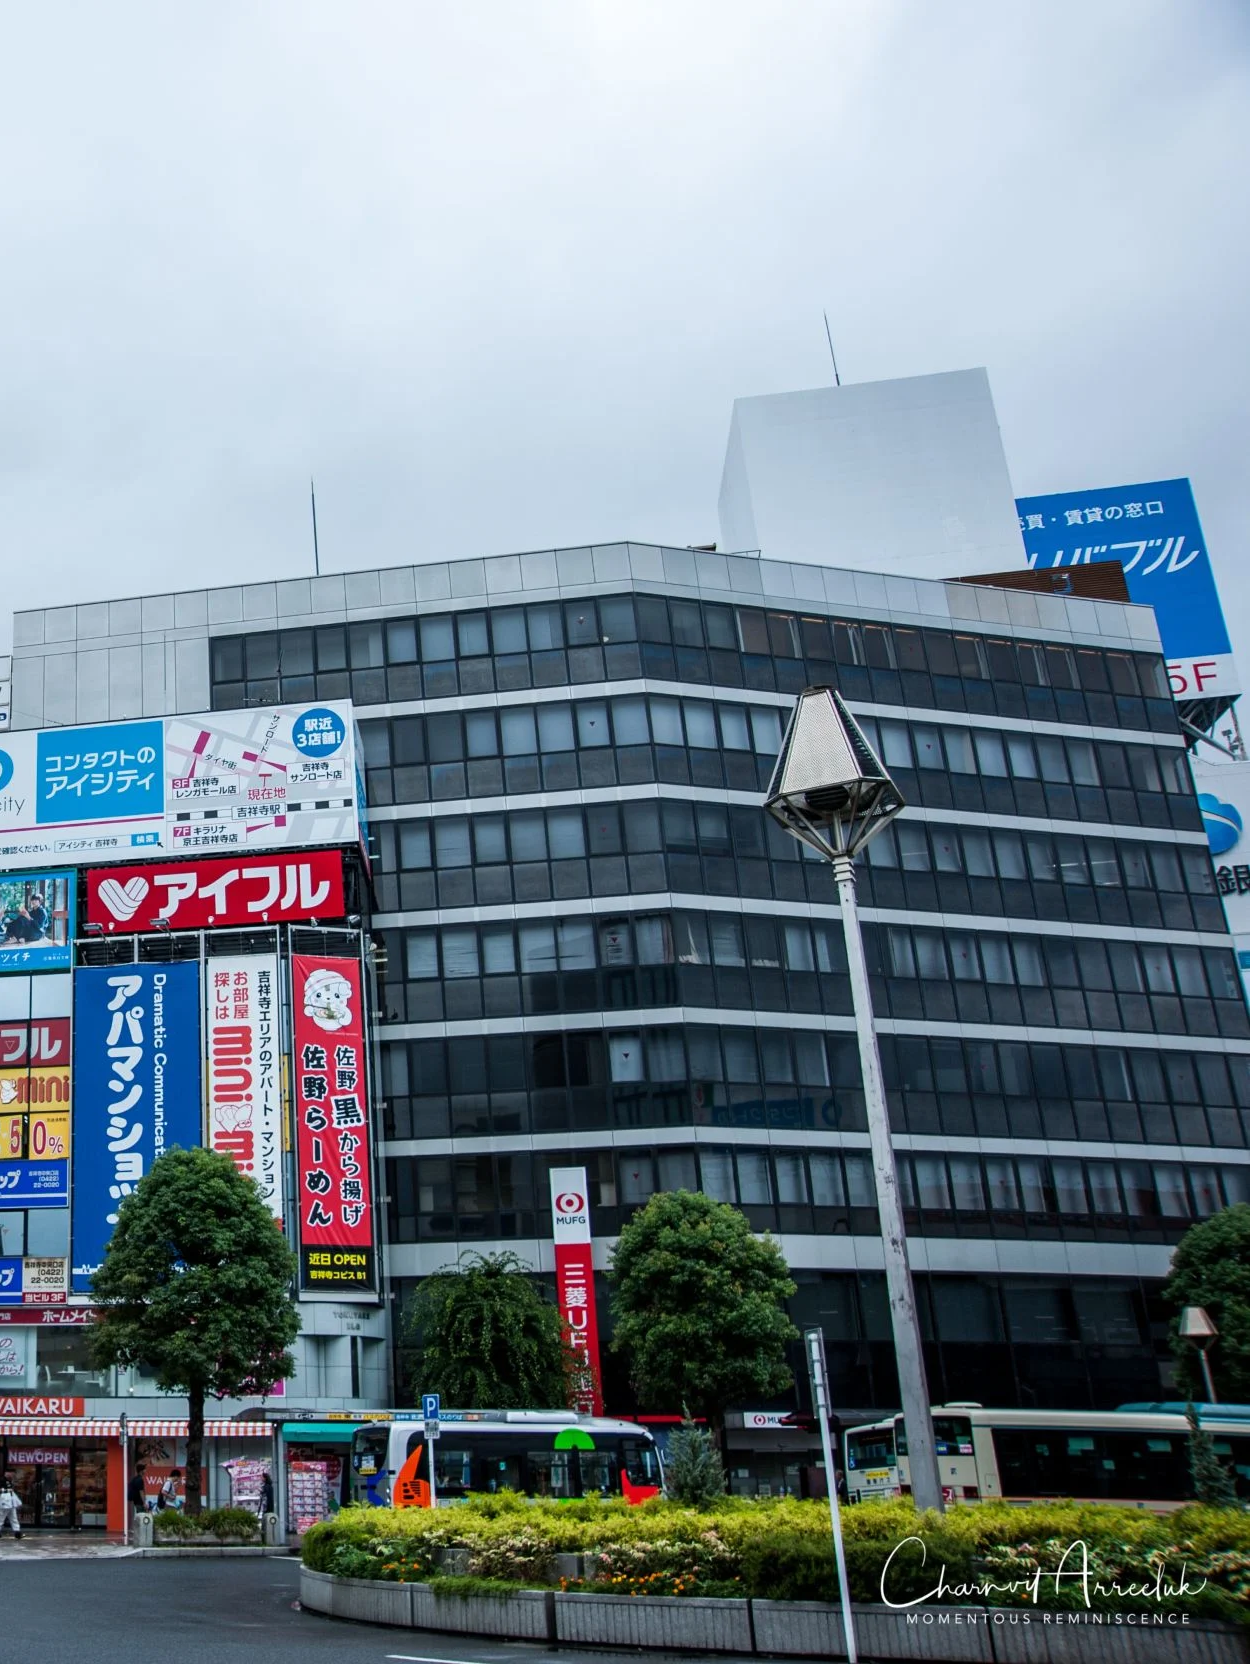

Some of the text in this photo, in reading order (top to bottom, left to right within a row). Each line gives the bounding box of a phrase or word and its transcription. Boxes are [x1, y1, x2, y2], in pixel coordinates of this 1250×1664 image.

[1167, 662, 1217, 694] 5F
[304, 717, 333, 732] 駅近
[260, 714, 281, 754] サンロード
[297, 733, 342, 748] 3店舗!
[45, 746, 156, 773] コンタクトの
[204, 753, 238, 771] ダイヤ街
[302, 763, 329, 772] 吉祥寺
[173, 777, 219, 789] 3F 吉祥寺
[290, 770, 343, 781] サンロード店
[45, 769, 156, 800] アイシティ
[176, 785, 237, 799] レンガモール店
[247, 786, 287, 801] 現在地
[236, 804, 281, 818] 吉祥寺駅
[174, 825, 227, 837] 7F キラリナ
[58, 838, 118, 850] アイシティ 吉祥寺
[182, 834, 238, 847] 京王吉祥寺店
[153, 862, 331, 919] アイフル
[213, 971, 230, 1020] 探しは
[232, 970, 250, 1019] お部屋
[153, 973, 168, 1160] Dramatic Communicat
[212, 1025, 253, 1103] mini
[17, 1075, 70, 1104] mini
[106, 974, 144, 1225] アパマンショ
[302, 1045, 332, 1227] 佐野らーめん
[556, 1216, 586, 1225] MUFG
[309, 1252, 367, 1266] 近日 OPEN
[37, 1268, 64, 1276] (0422)
[310, 1269, 367, 1280] 吉祥寺コピス B1
[30, 1276, 65, 1284] 22-0020
[24, 1293, 64, 1303] 当ビル 3F
[426, 1397, 436, 1418] P
[33, 1450, 69, 1463] OPEN
